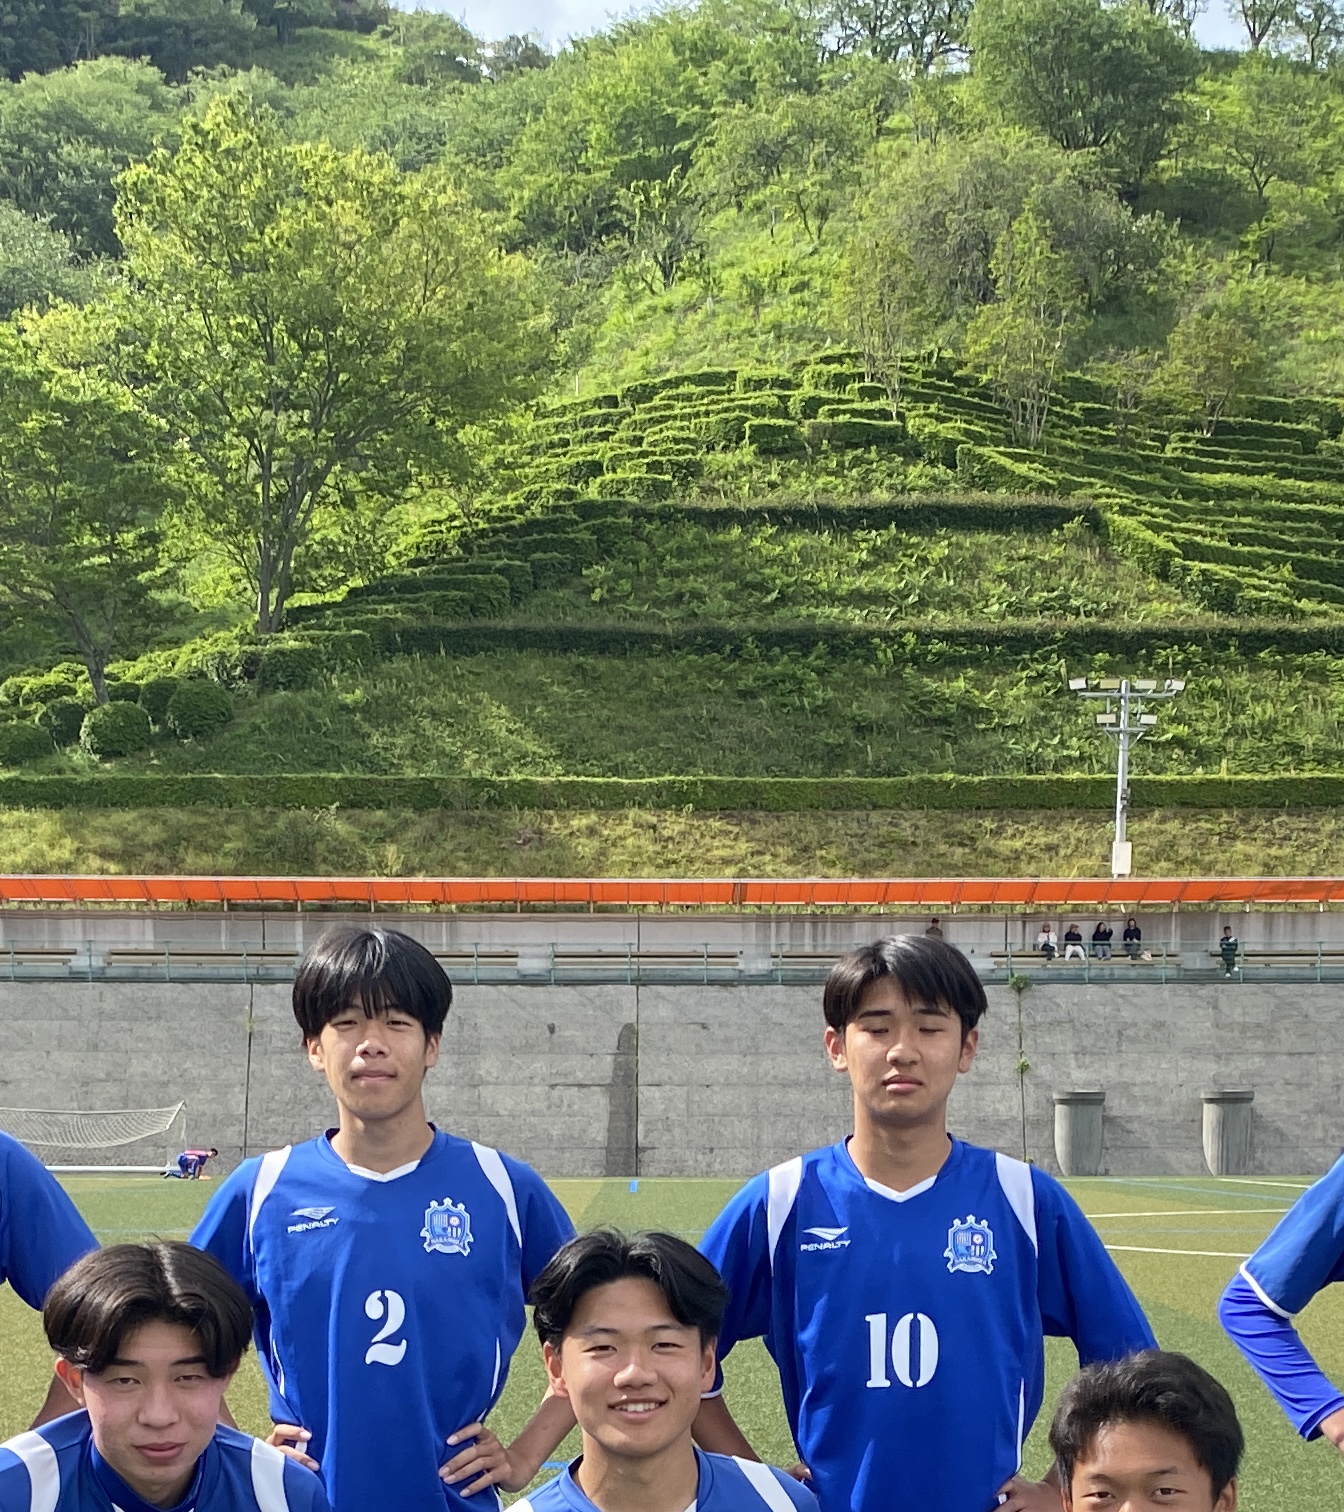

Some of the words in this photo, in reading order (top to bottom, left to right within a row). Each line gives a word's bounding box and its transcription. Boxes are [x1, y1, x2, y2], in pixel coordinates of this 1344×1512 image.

[287, 1218, 339, 1234] PENALTY
[800, 1240, 851, 1251] PENALTY
[365, 1289, 407, 1366] 2
[865, 1312, 939, 1388] 10
